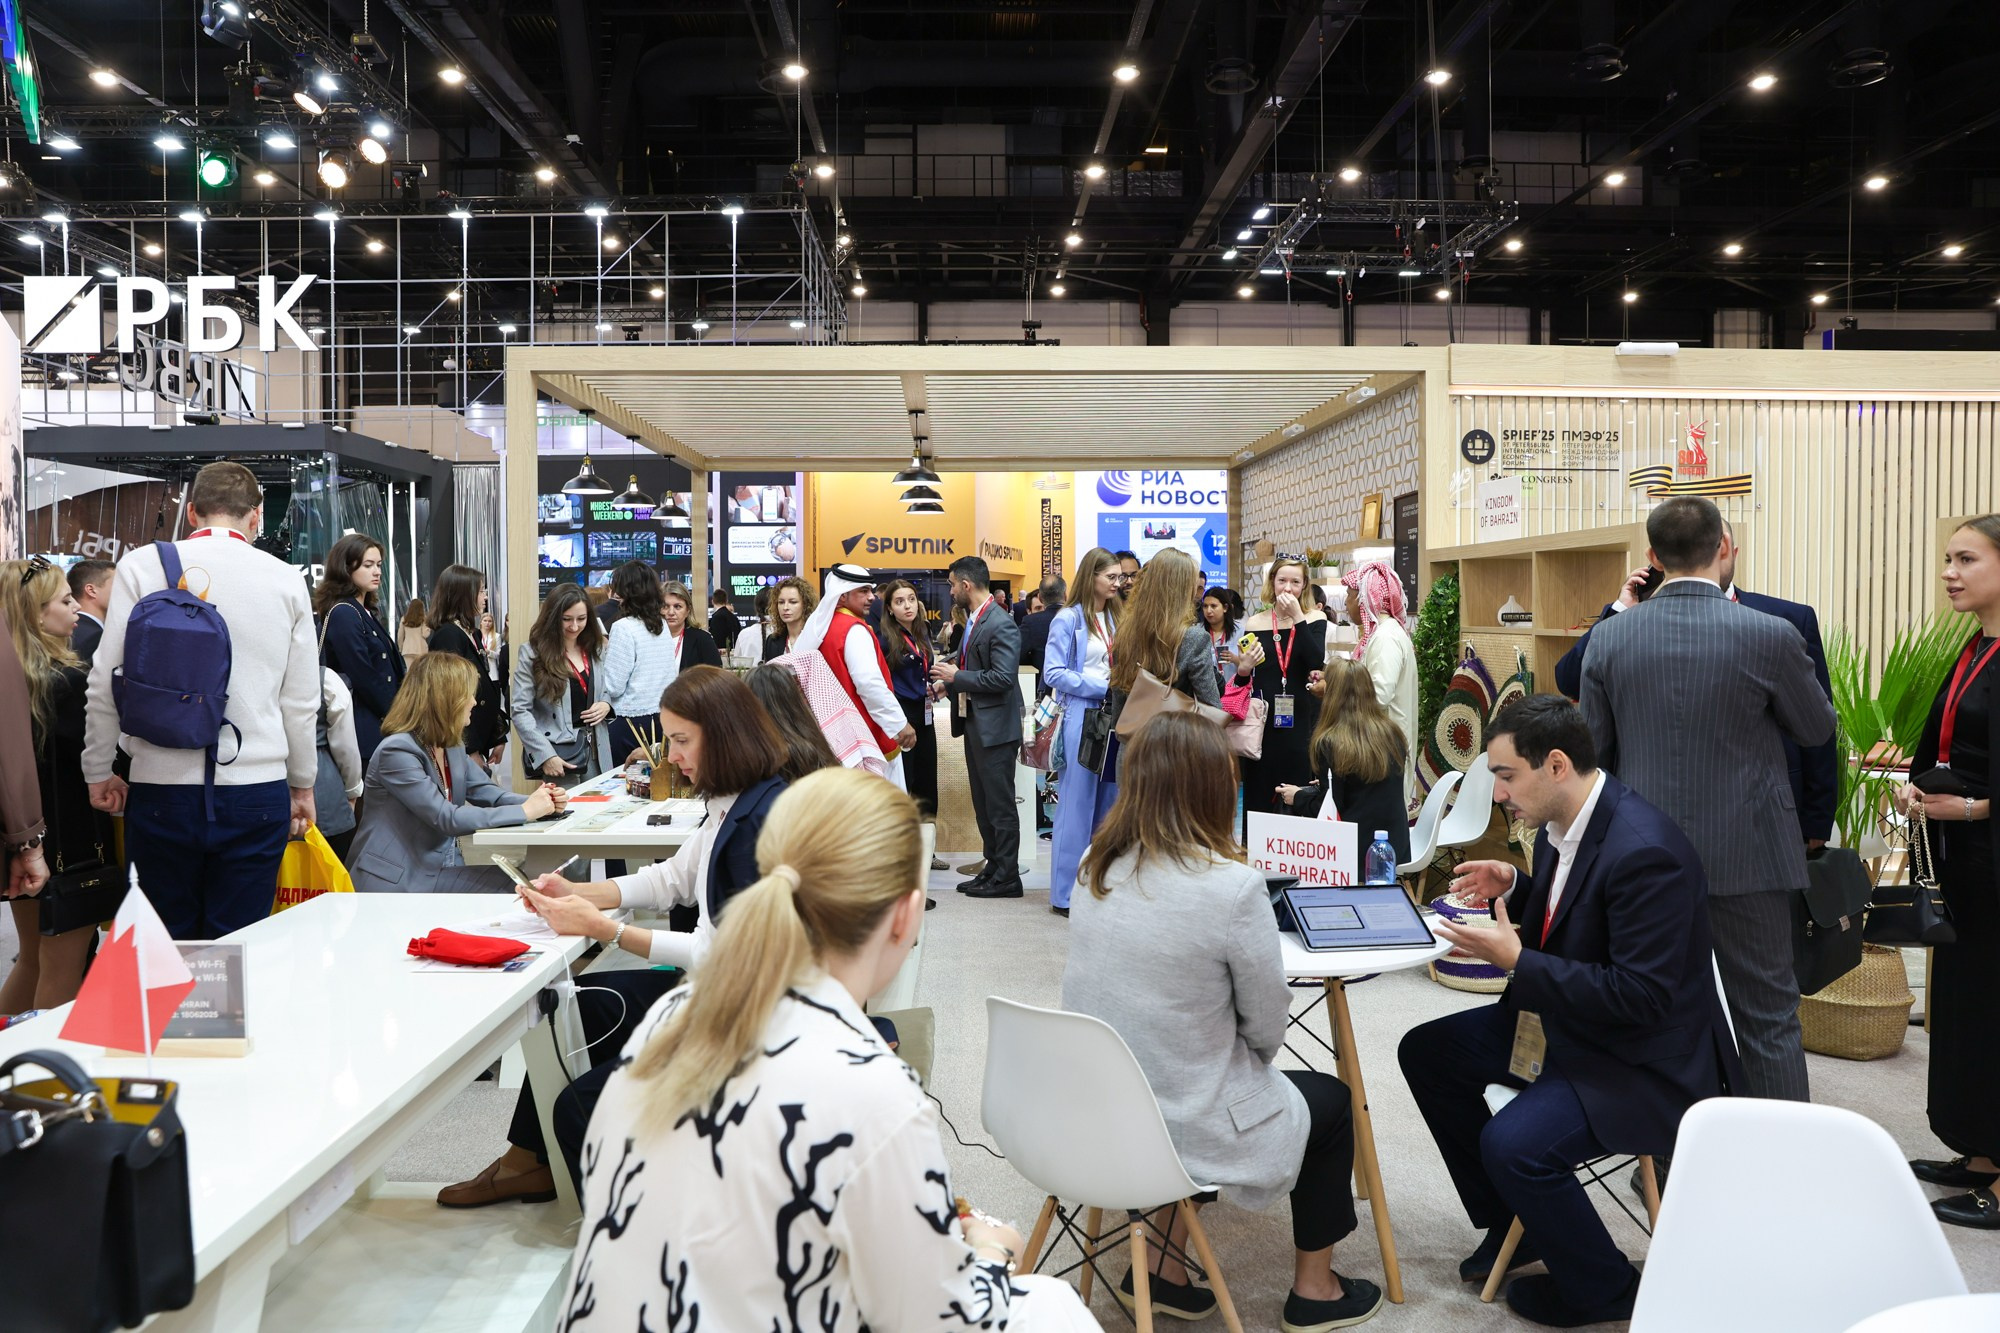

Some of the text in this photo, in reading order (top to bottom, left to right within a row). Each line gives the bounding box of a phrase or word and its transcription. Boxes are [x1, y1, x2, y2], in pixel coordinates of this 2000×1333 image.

[117, 274, 319, 353] РБК
[1141, 470, 1184, 486] РИА
[1485, 495, 1513, 510] KINGDOM
[593, 511, 623, 520] WEEKEND
[1480, 512, 1518, 528] OF BAHRAIN
[866, 536, 955, 555] SPUTNIK
[984, 542, 1024, 562] РАДИО SPUTNIK
[1266, 837, 1337, 862] KINGDOM
[1279, 862, 1350, 886] BAHRAIN
[197, 959, 226, 968] Wi-Fi:
[202, 973, 228, 982] Wi-Fi:
